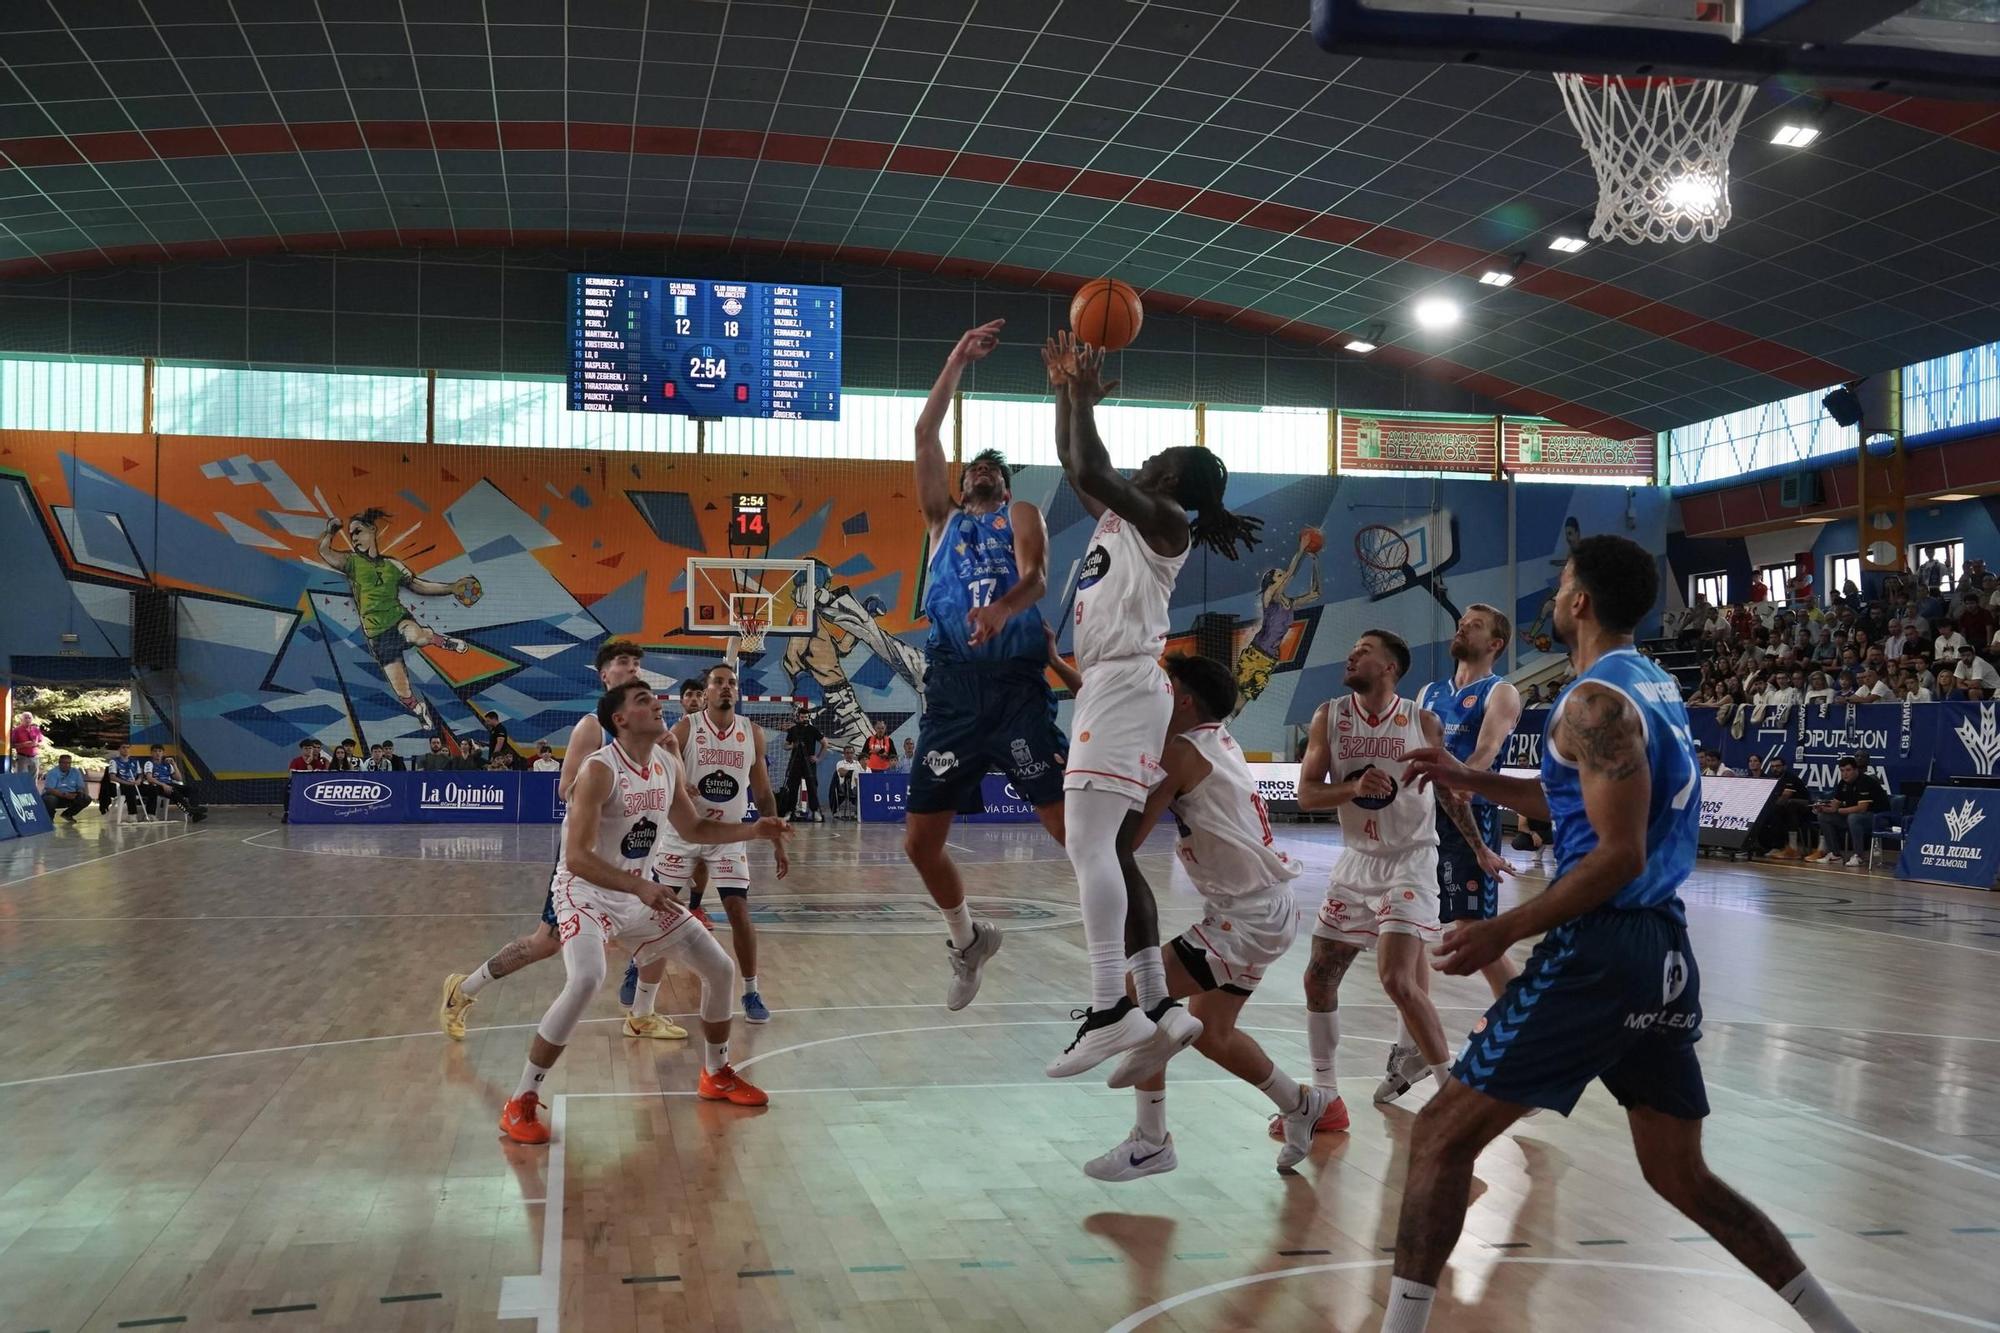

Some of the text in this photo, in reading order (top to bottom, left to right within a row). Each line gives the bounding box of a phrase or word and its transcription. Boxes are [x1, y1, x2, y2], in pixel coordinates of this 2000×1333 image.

[676, 318, 691, 335] 12
[724, 321, 739, 338] 18
[690, 358, 727, 379] 2:54
[643, 374, 648, 382] 3
[643, 395, 648, 403] 4
[1388, 432, 1478, 446] AYUNTAMIENTO
[1387, 444, 1479, 462] DE ZAMORA
[1548, 449, 1637, 464] DE ZAMORA
[739, 496, 765, 506] 2:54
[736, 514, 764, 534] 14
[968, 578, 997, 608] 17
[1339, 735, 1406, 761] 32005
[699, 748, 745, 770] 32005
[922, 756, 960, 768] ZAMORA
[706, 777, 734, 788] Estrella
[315, 785, 381, 799] FERRERO
[421, 782, 504, 808] La Opinión
[706, 786, 732, 796] Galicia
[984, 804, 1029, 814] VÍA DE LA
[1364, 819, 1380, 842] 41
[1921, 844, 1982, 860] CAJA RURAL
[1922, 857, 1968, 869] DE ZAMORA
